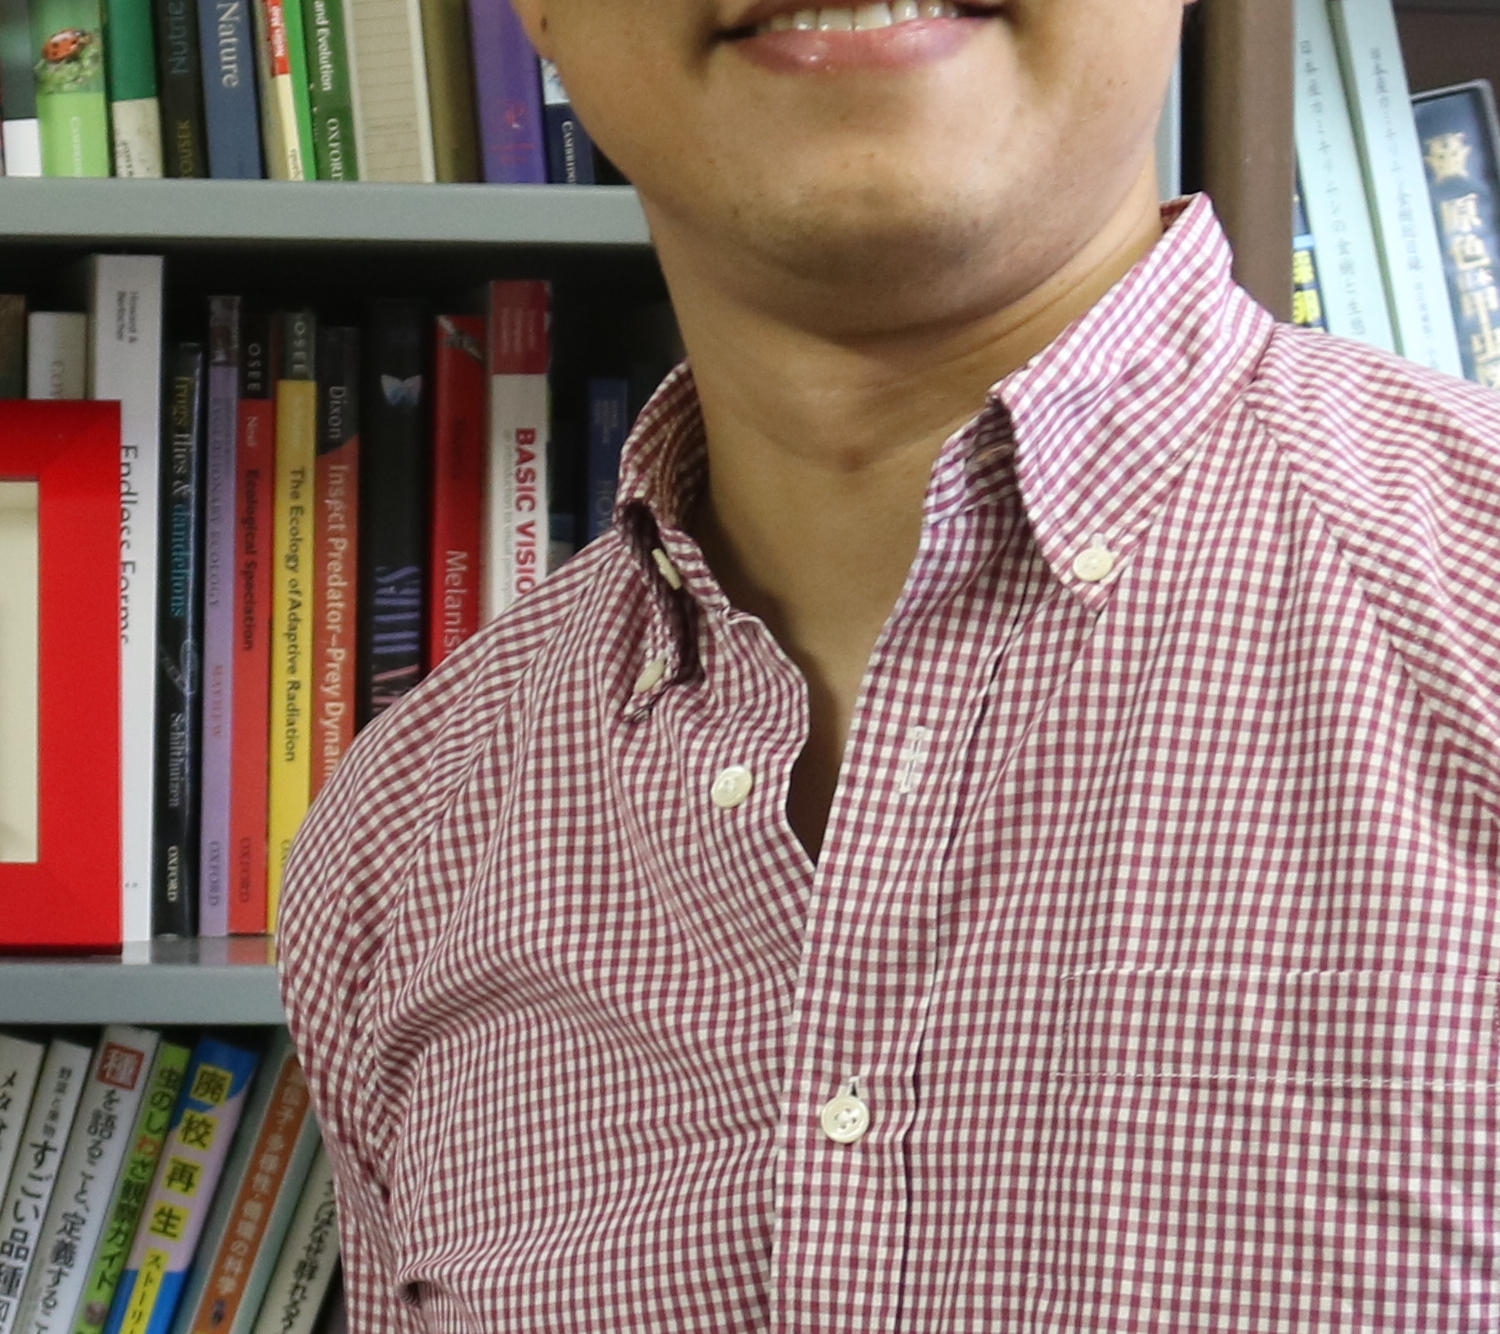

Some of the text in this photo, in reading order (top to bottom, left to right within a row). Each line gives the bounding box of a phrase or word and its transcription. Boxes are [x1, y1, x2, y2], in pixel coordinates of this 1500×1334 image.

[216, 1, 240, 89] Nature
[328, 386, 347, 439] Dixon
[325, 464, 349, 531] Insect
[514, 427, 537, 512] BASIC
[167, 845, 179, 902] OXFORD
[148, 1063, 234, 1244] 廃校再生
